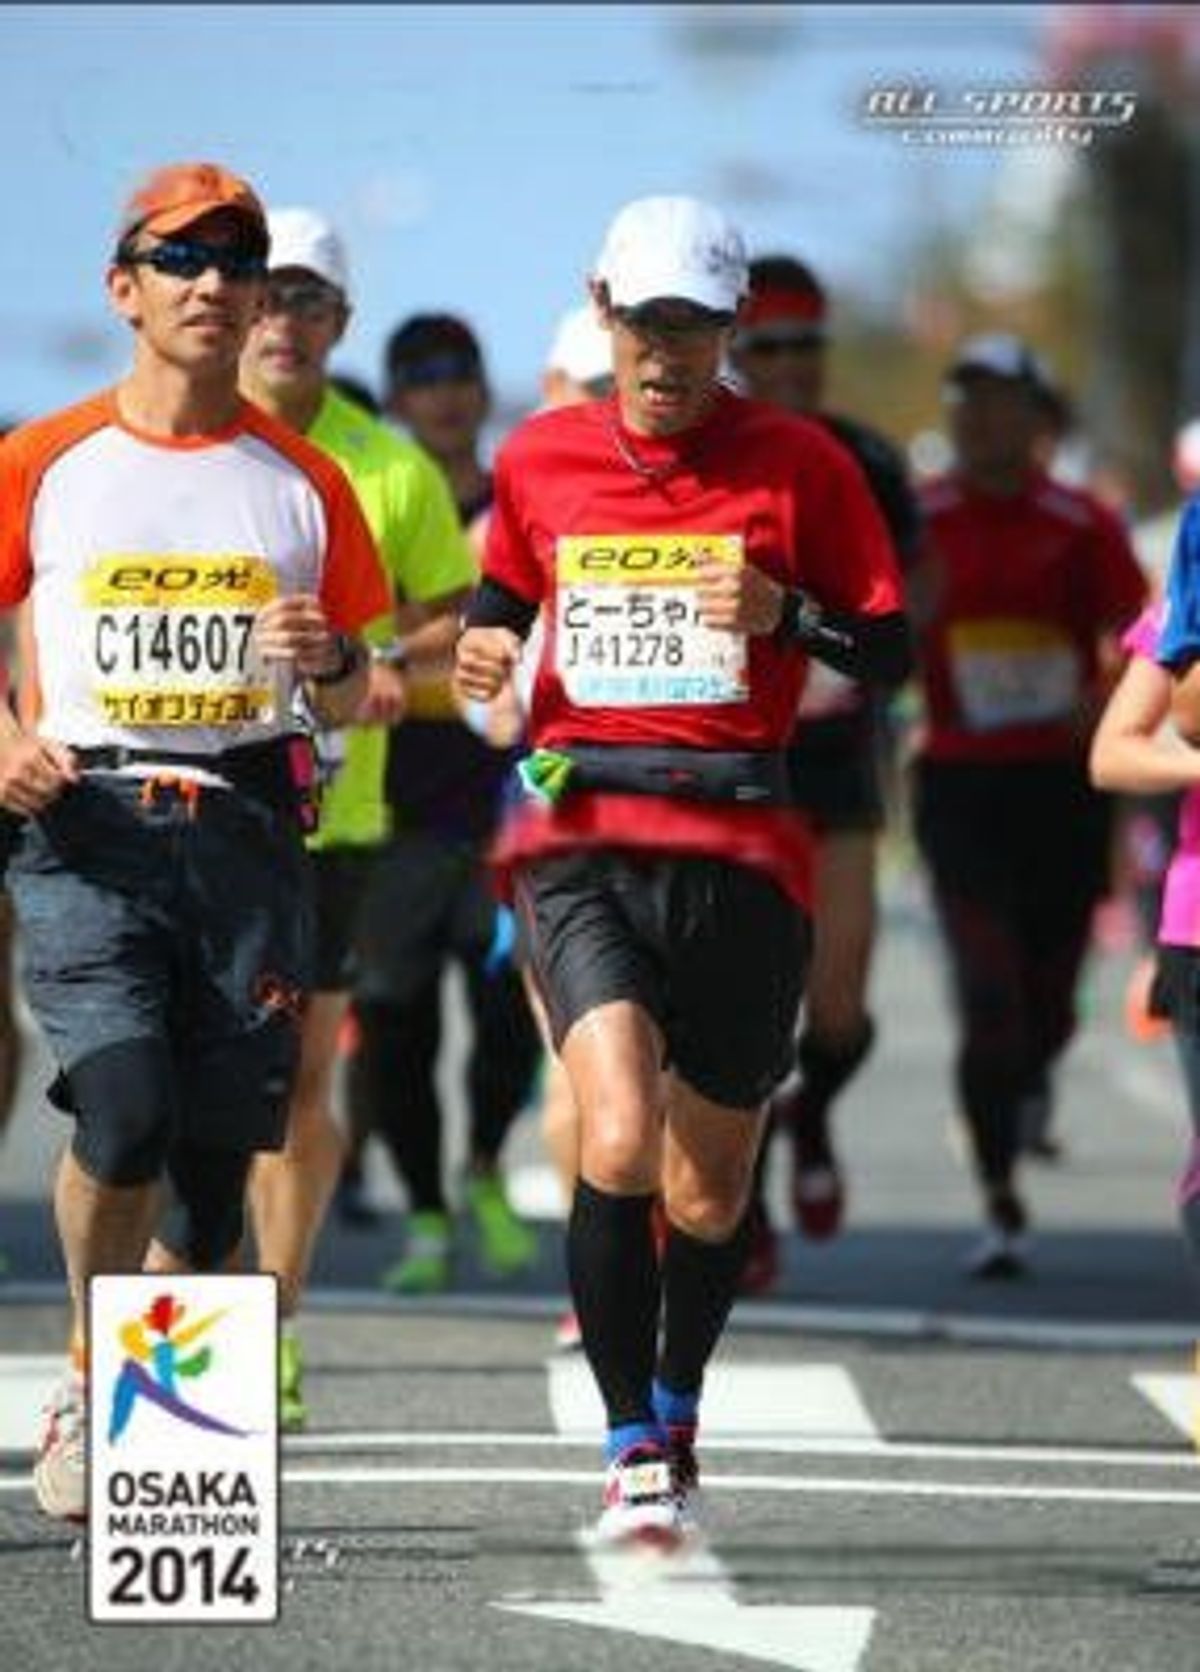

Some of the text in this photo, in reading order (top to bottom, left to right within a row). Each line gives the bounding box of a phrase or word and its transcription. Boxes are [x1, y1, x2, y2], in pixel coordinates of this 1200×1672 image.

[564, 592, 702, 629] とーちゃ
[96, 614, 255, 673] C14607
[566, 634, 684, 667] J41278
